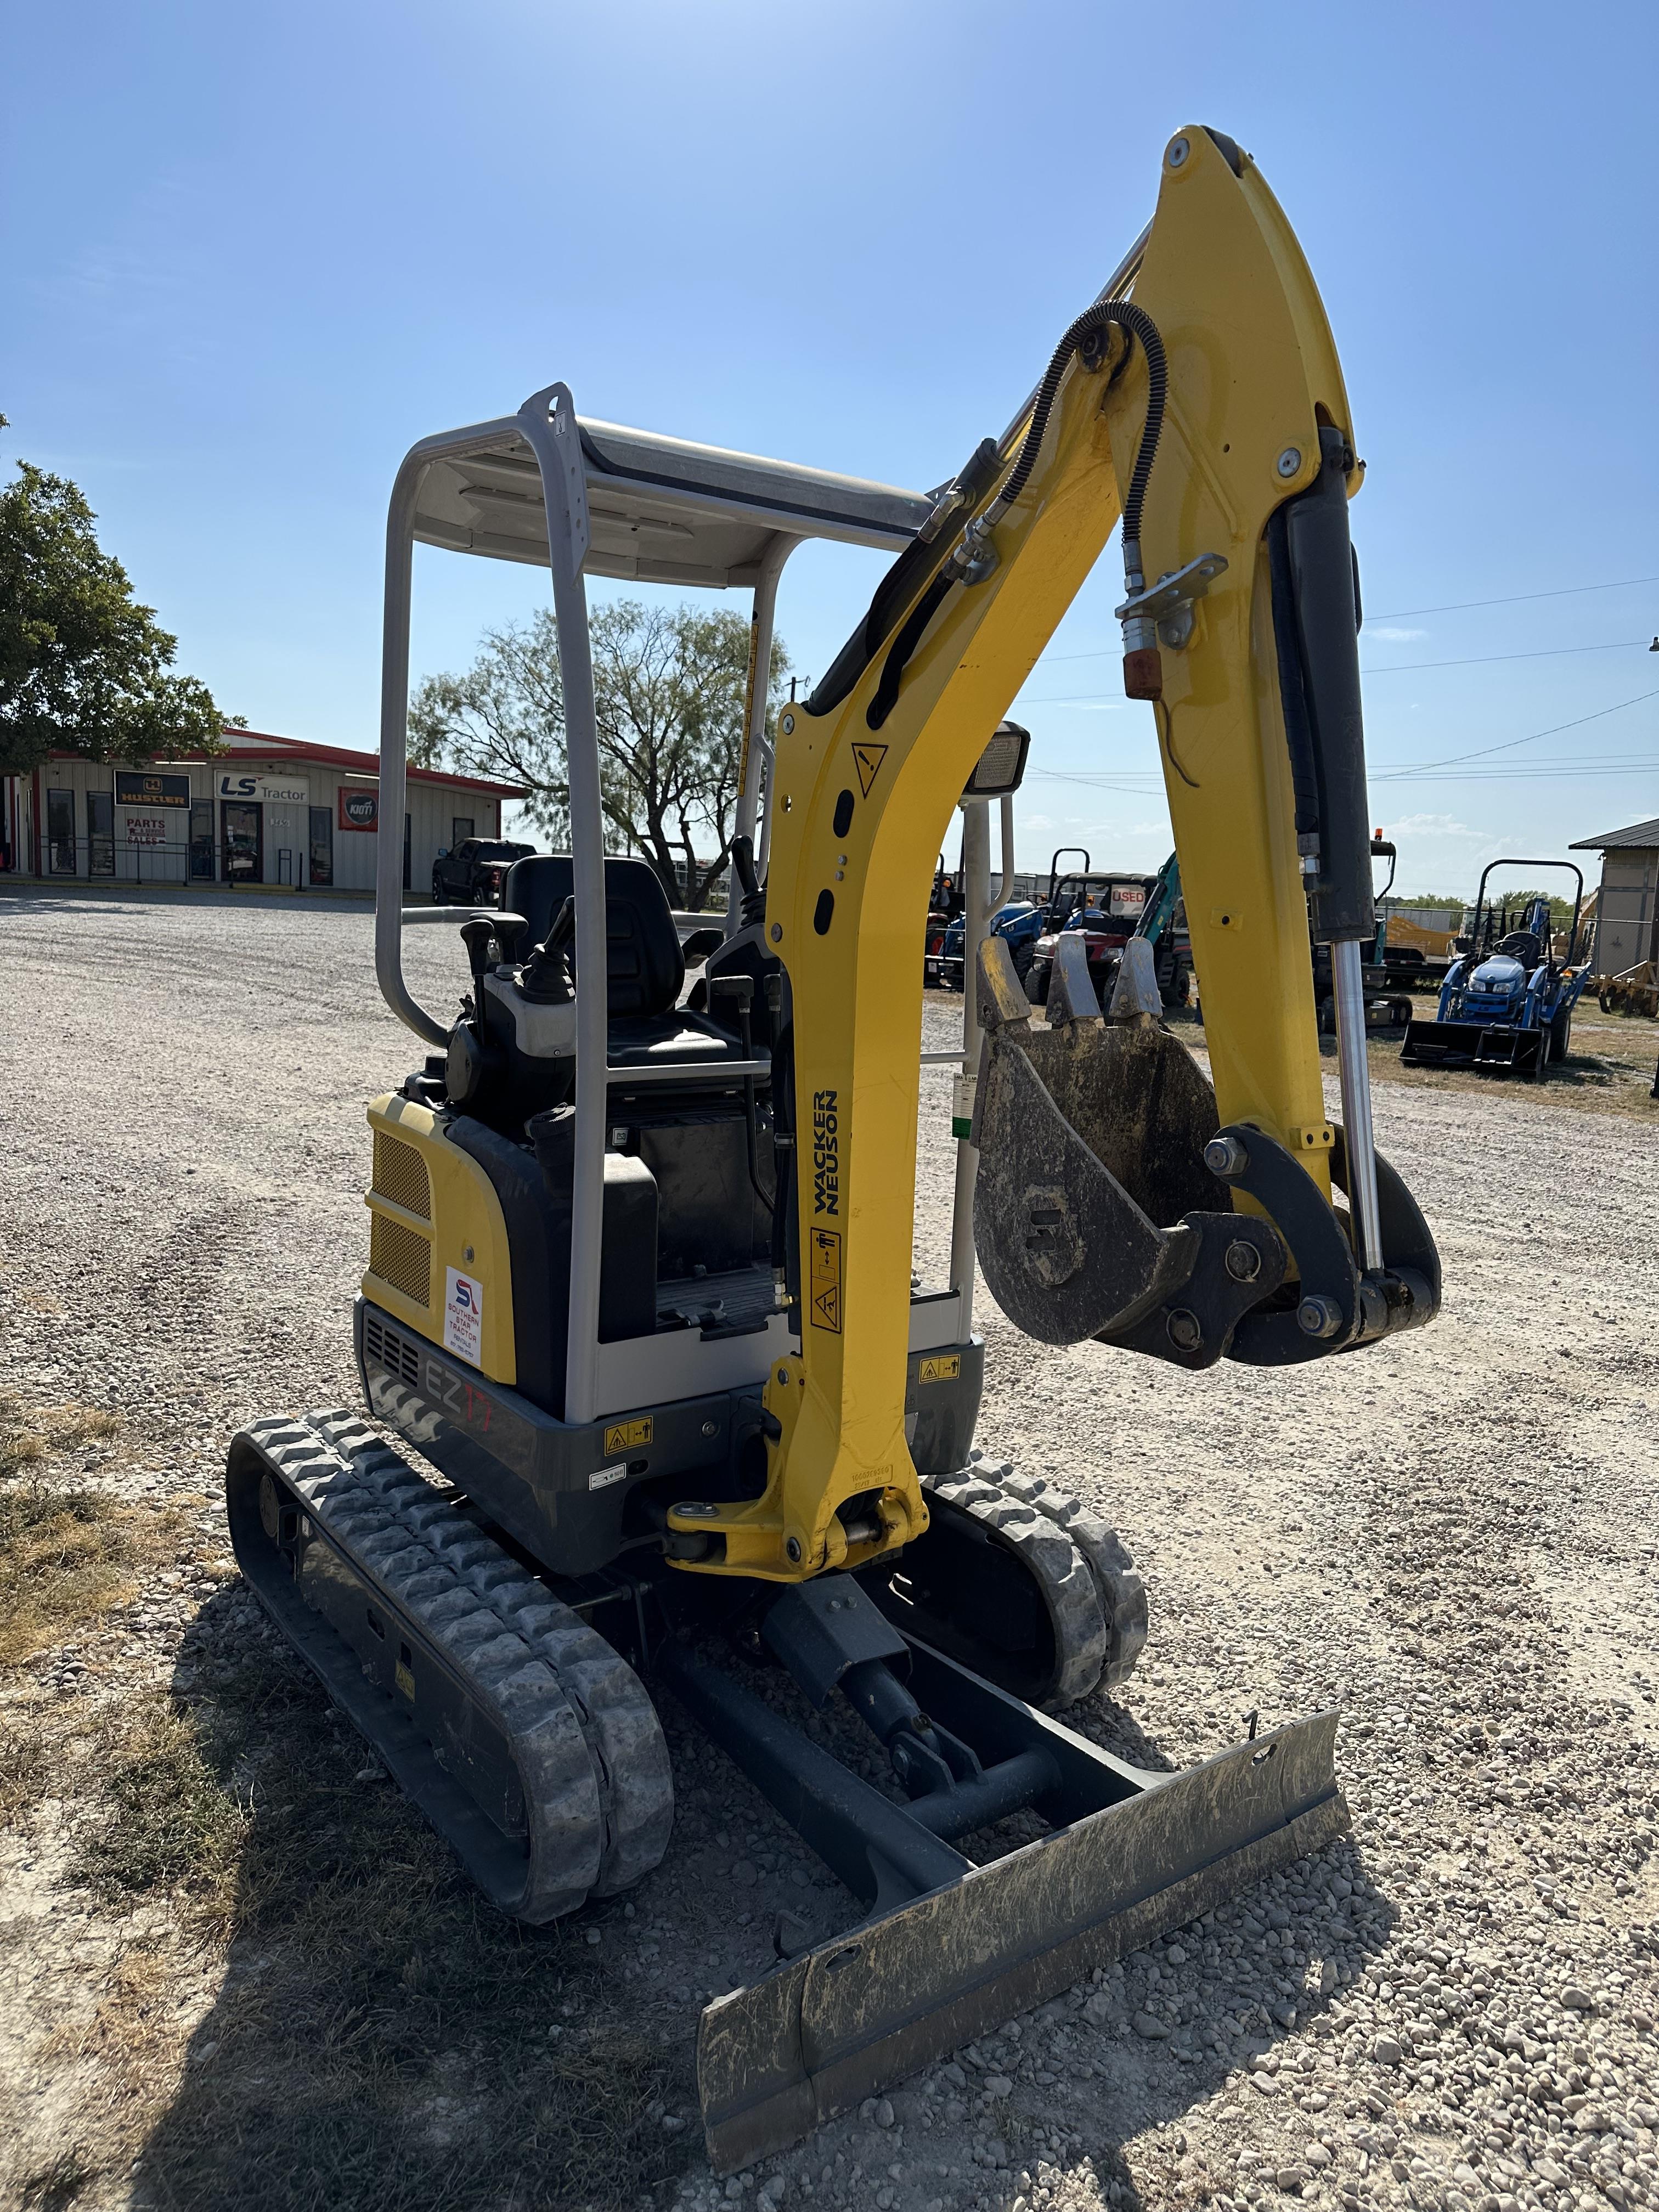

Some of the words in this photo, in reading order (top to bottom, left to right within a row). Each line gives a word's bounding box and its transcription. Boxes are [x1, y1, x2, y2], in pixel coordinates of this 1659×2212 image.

[221, 777, 256, 796] LS
[261, 787, 306, 800] Tractor
[121, 793, 185, 804] HUSTLER
[350, 802, 373, 815] KIOTI
[127, 819, 165, 828] PARTS
[127, 836, 158, 845] SALES
[1113, 890, 1144, 902] USED
[814, 1090, 826, 1214] WACKER
[826, 1090, 838, 1216] NEUSON
[448, 1303, 479, 1327] SOUTHERN
[456, 1316, 471, 1331] STAR
[449, 1321, 477, 1344] TRACTOR
[454, 1334, 471, 1348] RENTALS
[426, 1360, 492, 1432] EZ17
